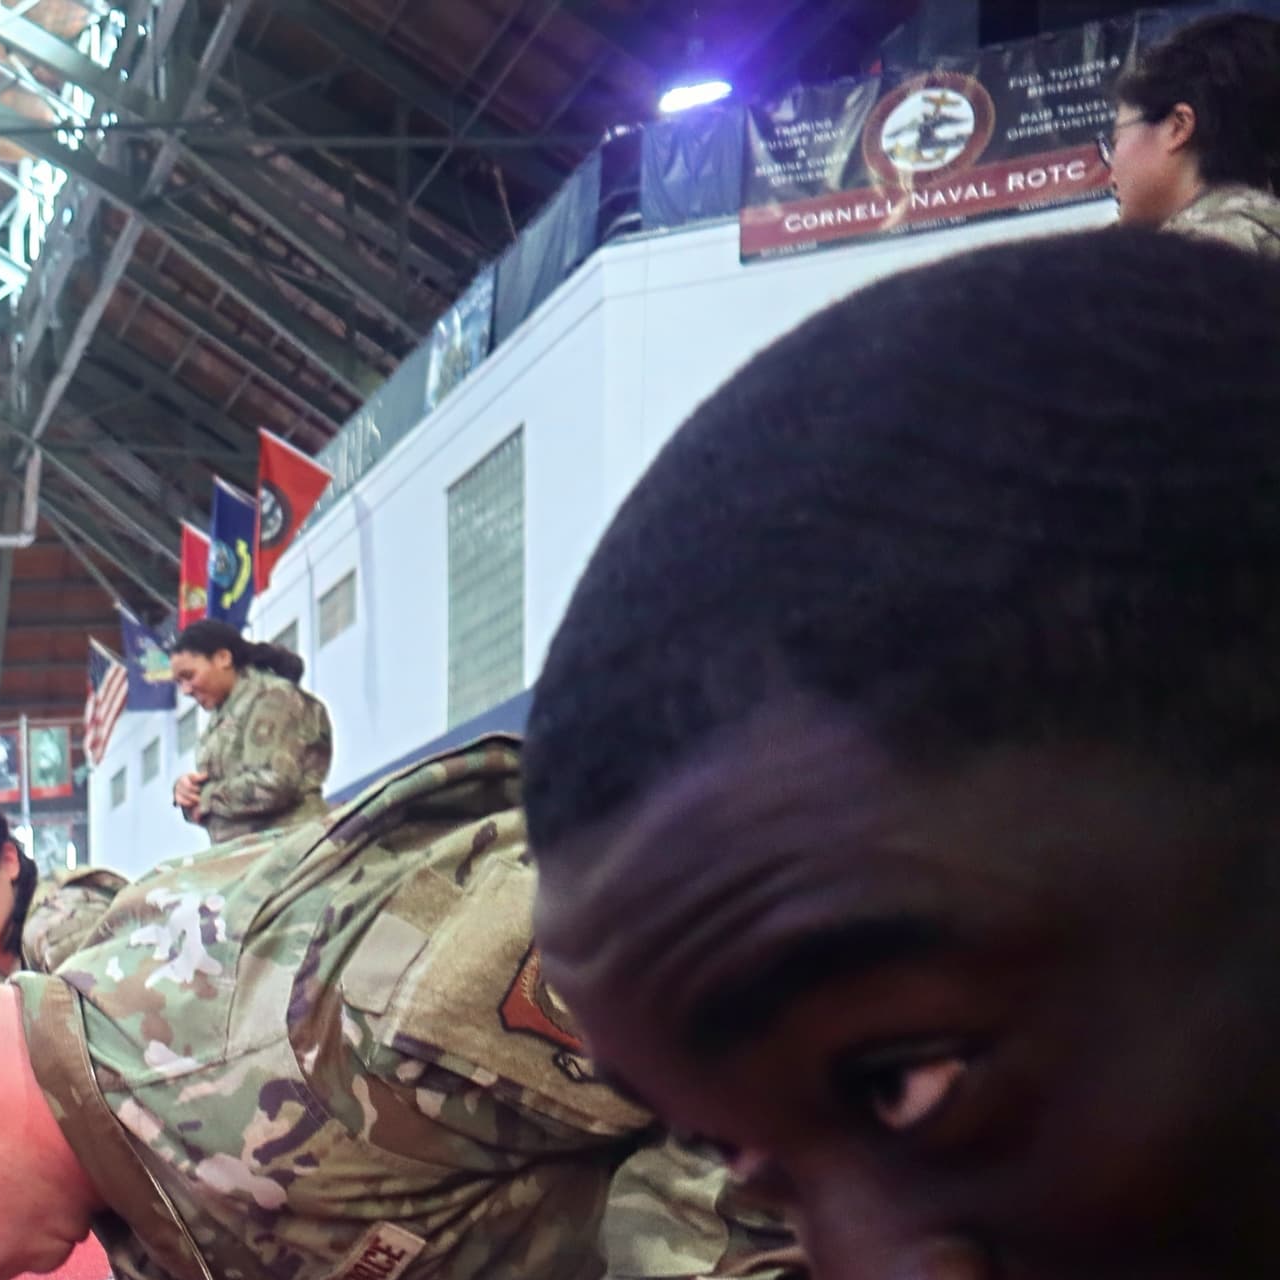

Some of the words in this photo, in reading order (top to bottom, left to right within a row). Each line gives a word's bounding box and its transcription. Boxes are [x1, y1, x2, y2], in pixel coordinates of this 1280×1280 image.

[1008, 73, 1042, 90] FULL
[1049, 60, 1105, 80] TUITION
[1020, 108, 1053, 124] PAID
[1057, 99, 1108, 117] TRAVEL
[759, 136, 810, 151] FUTURE
[813, 127, 847, 144] NAVY
[774, 118, 834, 137] TRAINING
[755, 161, 803, 177] MARINE
[807, 152, 848, 169] CORPS
[784, 202, 895, 233] CORNELL
[911, 181, 997, 209] NAVAL
[1007, 160, 1087, 193] ROTC
